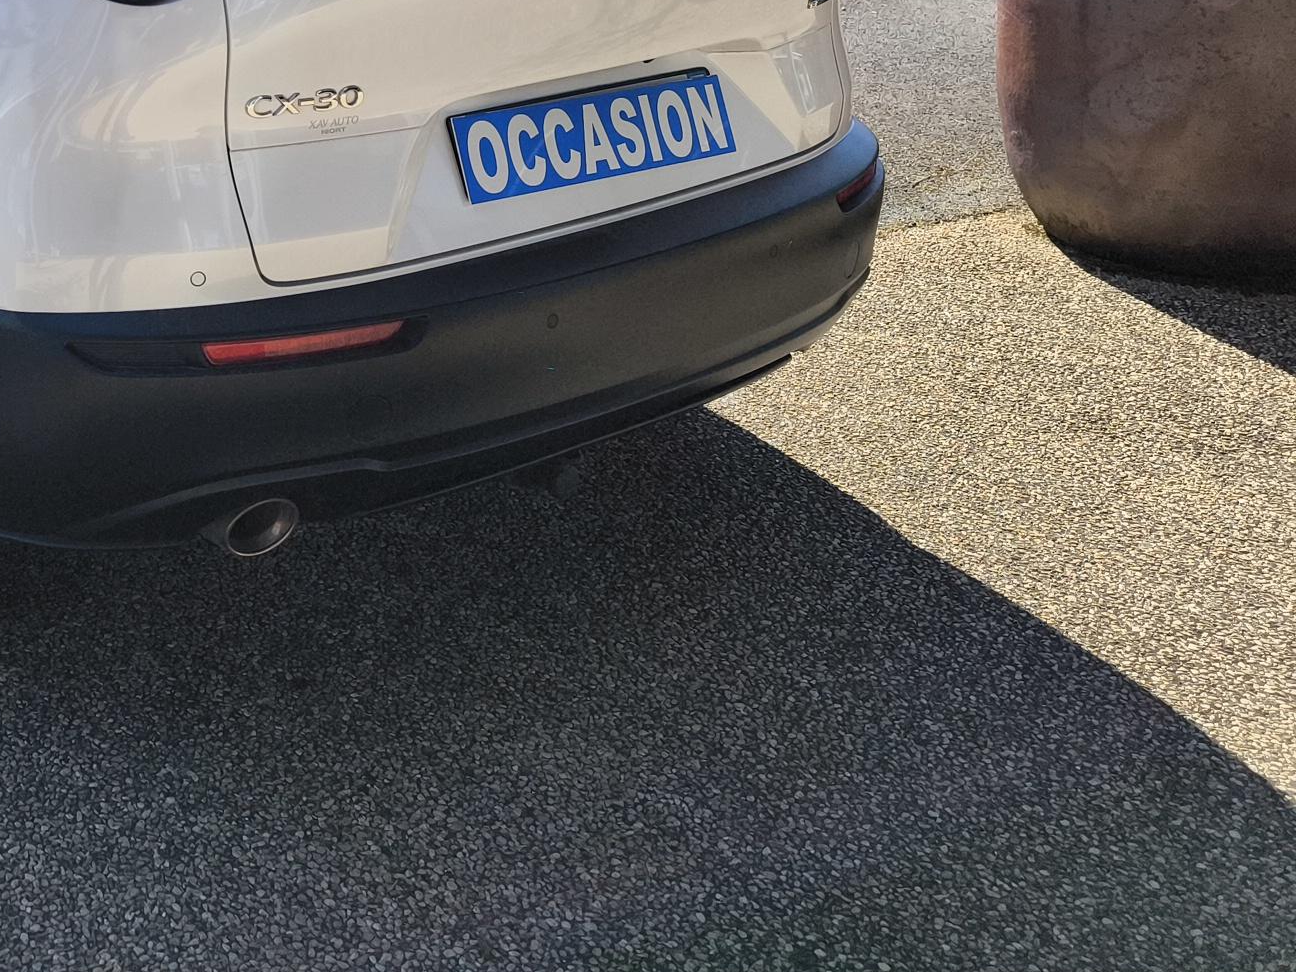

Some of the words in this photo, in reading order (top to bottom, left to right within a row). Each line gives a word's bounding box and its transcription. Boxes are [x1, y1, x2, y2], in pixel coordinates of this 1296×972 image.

[245, 84, 365, 119] CX-30
[333, 115, 360, 126] AUTO
[467, 83, 729, 194] OCCASION
